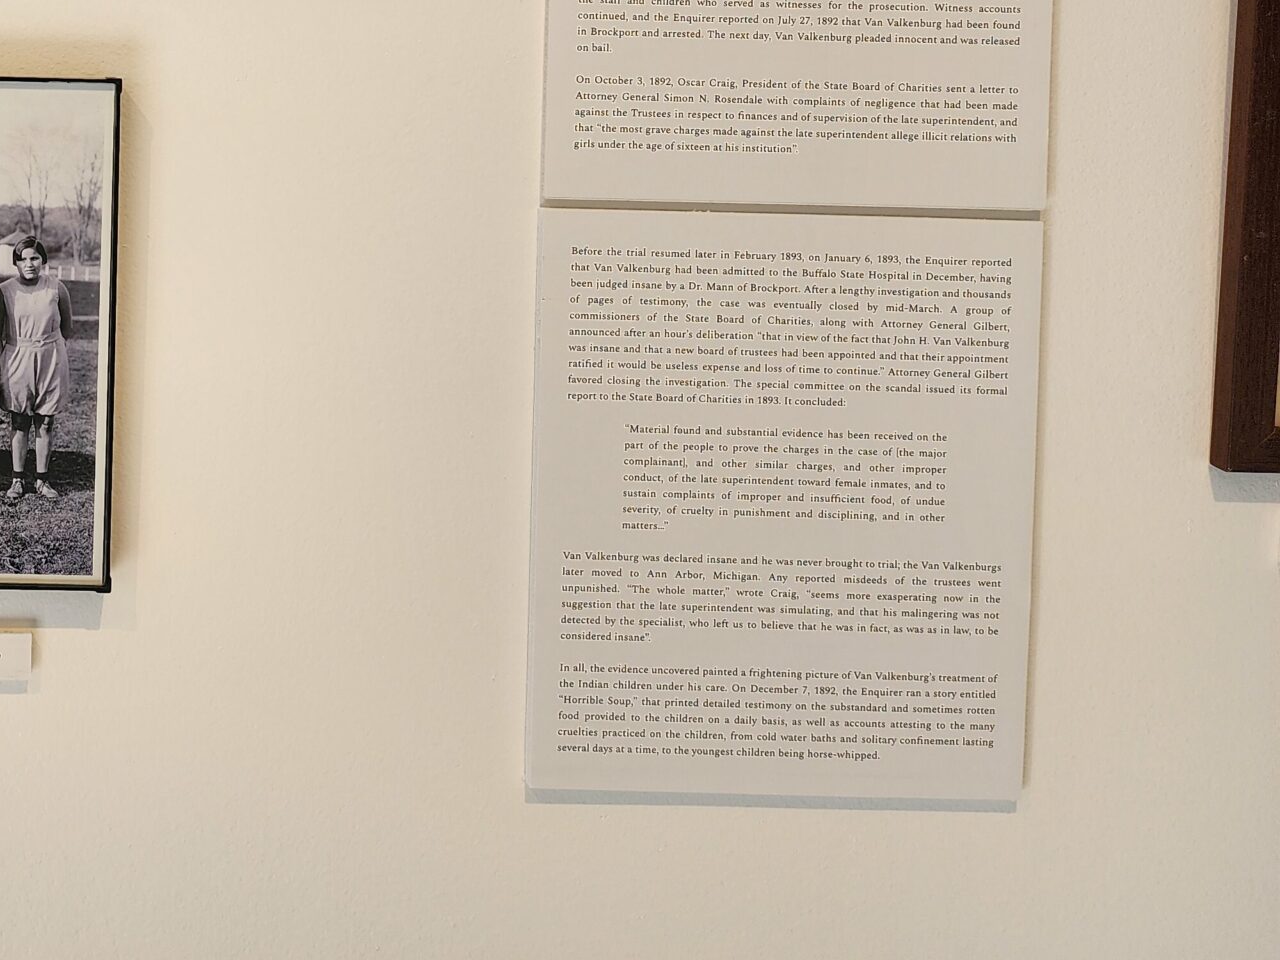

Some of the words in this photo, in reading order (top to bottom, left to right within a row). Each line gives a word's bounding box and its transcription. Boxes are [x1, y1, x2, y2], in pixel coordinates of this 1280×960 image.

[575, 91, 618, 102] Attorney
[621, 91, 659, 101] General
[663, 93, 694, 102] Simon
[698, 93, 709, 103] N.
[714, 93, 763, 104] Rosendale
[766, 94, 788, 105] with
[792, 95, 845, 108] complaints
[849, 96, 861, 107] of
[864, 97, 916, 110] negligence
[920, 98, 940, 108] that
[943, 99, 961, 109] had
[965, 99, 988, 110] been
[992, 100, 1018, 110] made
[571, 245, 602, 256] Before
[606, 246, 622, 256] the
[626, 247, 646, 257] trial
[650, 247, 691, 258] resumed
[694, 249, 717, 259] later
[720, 249, 730, 259] in
[734, 250, 777, 262] February
[780, 251, 804, 262] 1893,
[808, 254, 820, 262] on
[823, 252, 861, 264] January
[863, 254, 873, 264] 6,
[877, 254, 901, 265] 1893,
[905, 254, 921, 264] the
[924, 255, 968, 268] Enquirer
[971, 256, 1012, 269] reported
[569, 310, 640, 321] commissioners
[646, 311, 658, 321] of
[663, 312, 679, 322] the
[684, 313, 709, 323] State
[716, 313, 744, 324] Board
[751, 314, 762, 324] of
[767, 315, 813, 327] Charities,
[819, 316, 846, 329] along
[851, 317, 874, 327] with
[880, 319, 923, 331] Attorney
[928, 319, 966, 330] General
[973, 321, 1010, 333] Gilbert,
[623, 455, 688, 469] complainant],
[695, 457, 713, 467] and
[721, 458, 747, 468] other
[754, 459, 788, 469] similar
[796, 460, 835, 473] charges,
[843, 461, 861, 471] and
[868, 462, 895, 472] other
[902, 464, 947, 476] improper
[562, 566, 584, 576] later
[591, 566, 622, 577] moved
[646, 569, 667, 578] Ann
[674, 569, 705, 581] Arbor,
[712, 570, 760, 583] Michigan.
[768, 572, 788, 584] Any
[795, 573, 836, 585] reported
[843, 574, 888, 584] misdeeds
[894, 575, 906, 585] of
[911, 576, 927, 586] the
[933, 578, 971, 587] trustees
